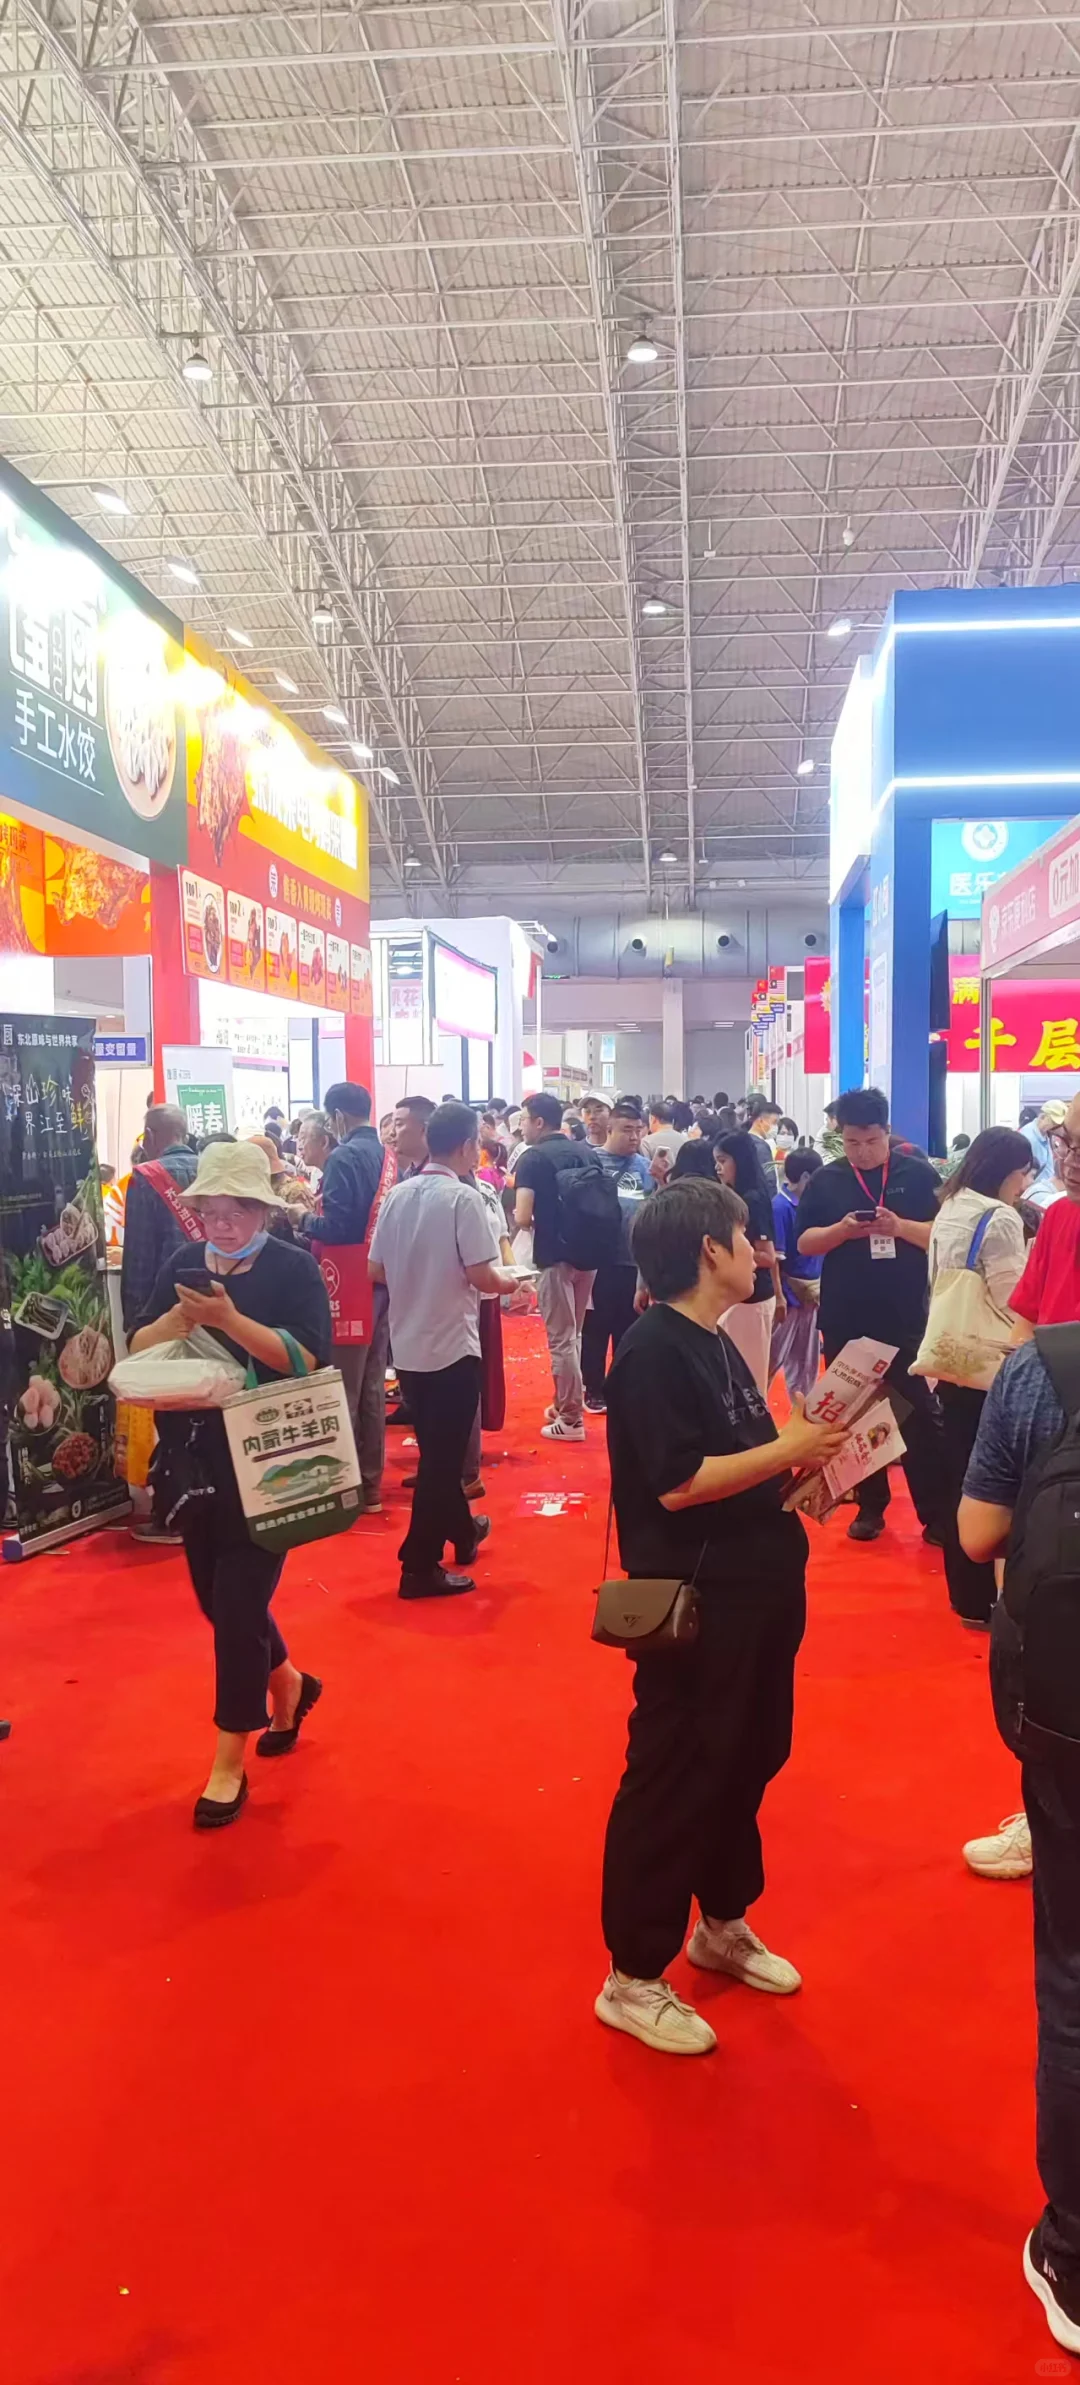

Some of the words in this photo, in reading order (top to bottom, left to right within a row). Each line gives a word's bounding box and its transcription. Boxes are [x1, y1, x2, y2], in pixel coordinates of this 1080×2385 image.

[15, 688, 96, 782] 手工水饺
[811, 1390, 847, 1423] 招
[243, 1415, 341, 1456] 内蒙牛羊肉
